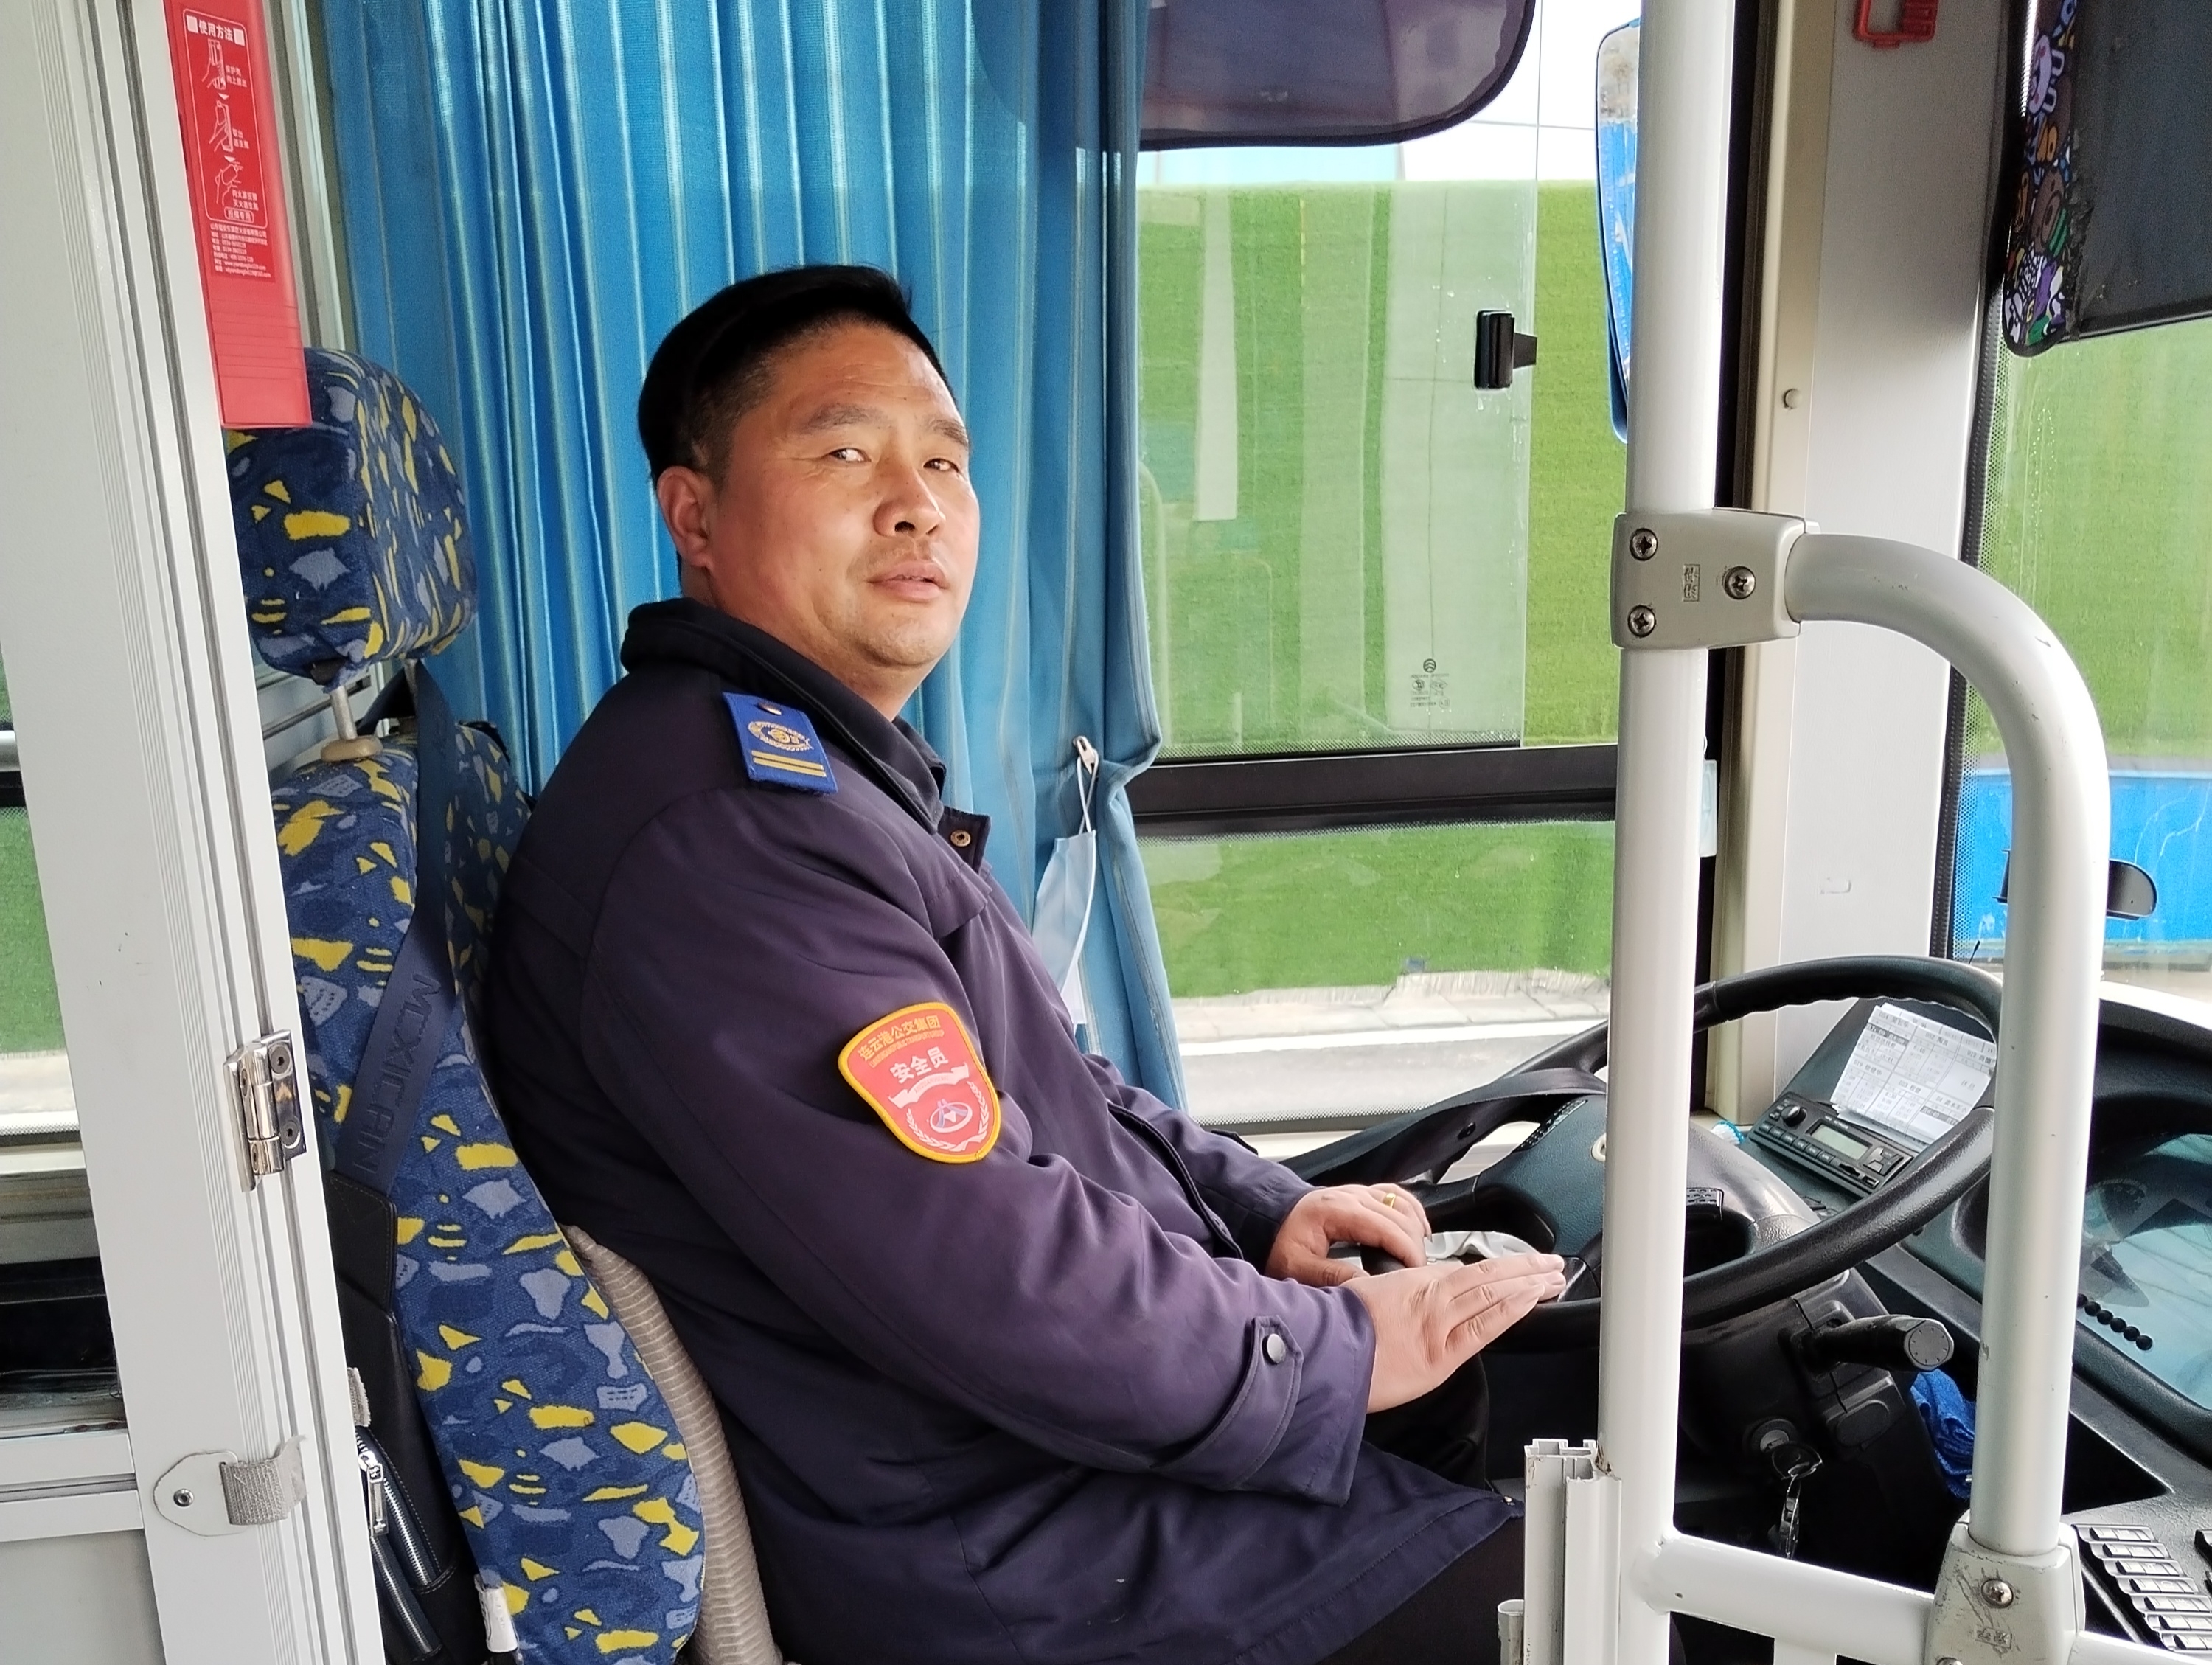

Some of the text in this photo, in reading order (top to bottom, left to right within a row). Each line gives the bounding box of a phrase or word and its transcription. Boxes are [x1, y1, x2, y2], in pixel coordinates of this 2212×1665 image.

[198, 18, 234, 42] 使用方法
[858, 1015, 941, 1061] 连云港公交集团
[890, 1046, 949, 1084] 安全员
